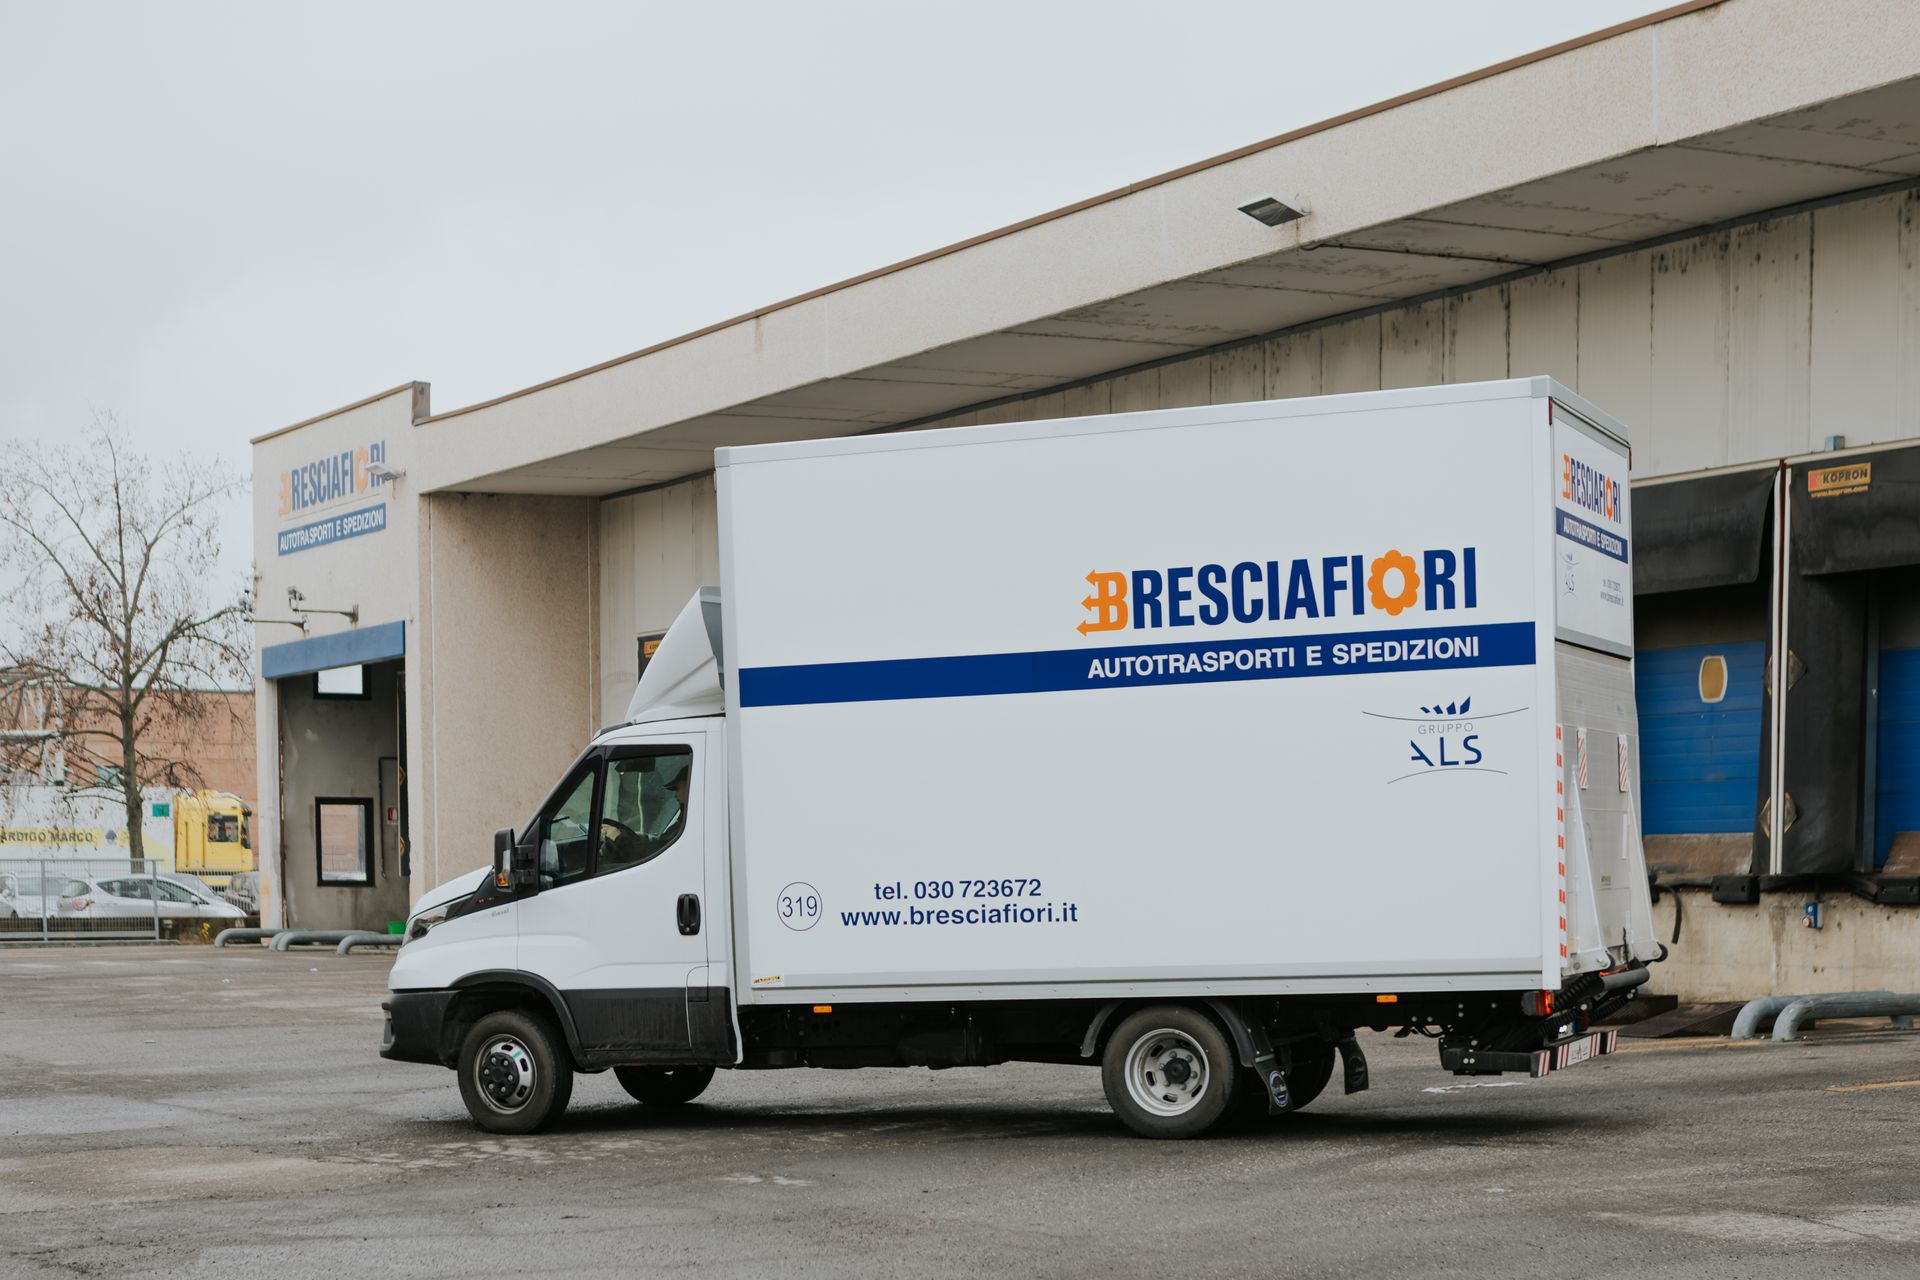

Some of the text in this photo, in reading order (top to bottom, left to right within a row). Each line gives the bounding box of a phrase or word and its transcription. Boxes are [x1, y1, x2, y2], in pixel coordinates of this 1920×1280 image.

[278, 440, 386, 518] BRESCIAFIORI
[1563, 454, 1621, 524] BRESCIAFIORI
[1823, 469, 1867, 484] KOPRON
[280, 509, 384, 552] AUTOTRASPORTI E SPEDIZIONI
[1077, 546, 1477, 637] BRESCIAFIORI
[1088, 636, 1479, 679] AUTOTRASPORTI E SPEDIZIONI
[1417, 722, 1474, 735] GRUPPO
[1410, 735, 1482, 767] ALS
[50, 831, 94, 844] MARCO
[874, 878, 1042, 900] tel. 030 723672
[782, 895, 818, 918] 319
[841, 902, 1079, 926] www.bresciafiori.it
